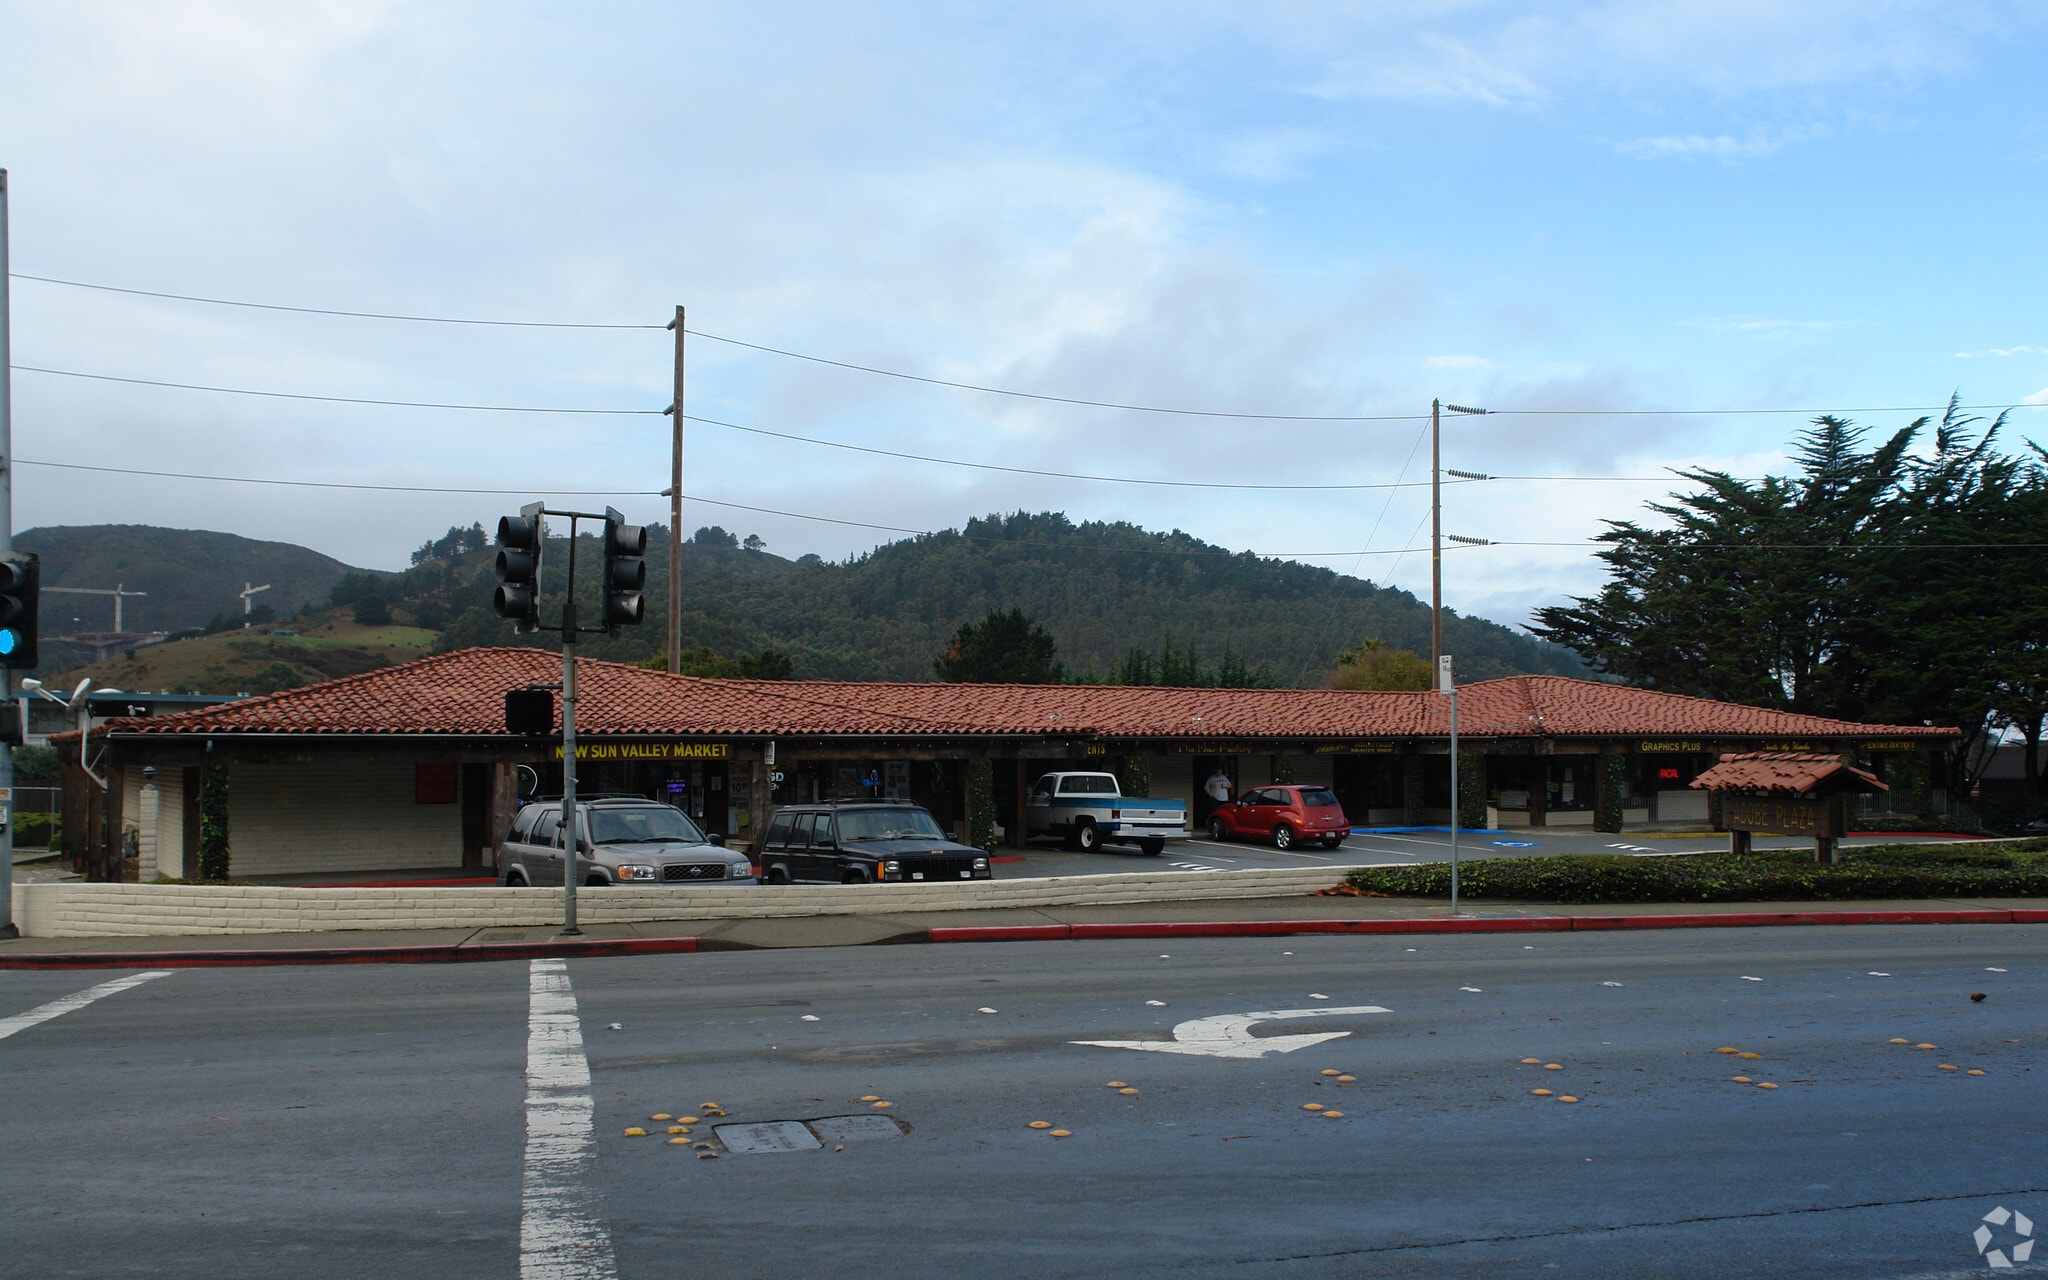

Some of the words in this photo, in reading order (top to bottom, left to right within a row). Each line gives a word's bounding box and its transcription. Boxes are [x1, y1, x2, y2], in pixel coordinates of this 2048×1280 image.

[555, 745, 588, 758] NW
[591, 744, 617, 758] SUN
[620, 744, 670, 757] VALLEY
[673, 743, 728, 757] MARKET
[1087, 743, 1106, 755] ENTS
[1219, 742, 1252, 754] Factory
[1641, 741, 1680, 751] GRAPHICS
[1682, 741, 1701, 751] PLUS
[1733, 802, 1768, 826] ADOBE
[1775, 804, 1815, 830] PLAZA
